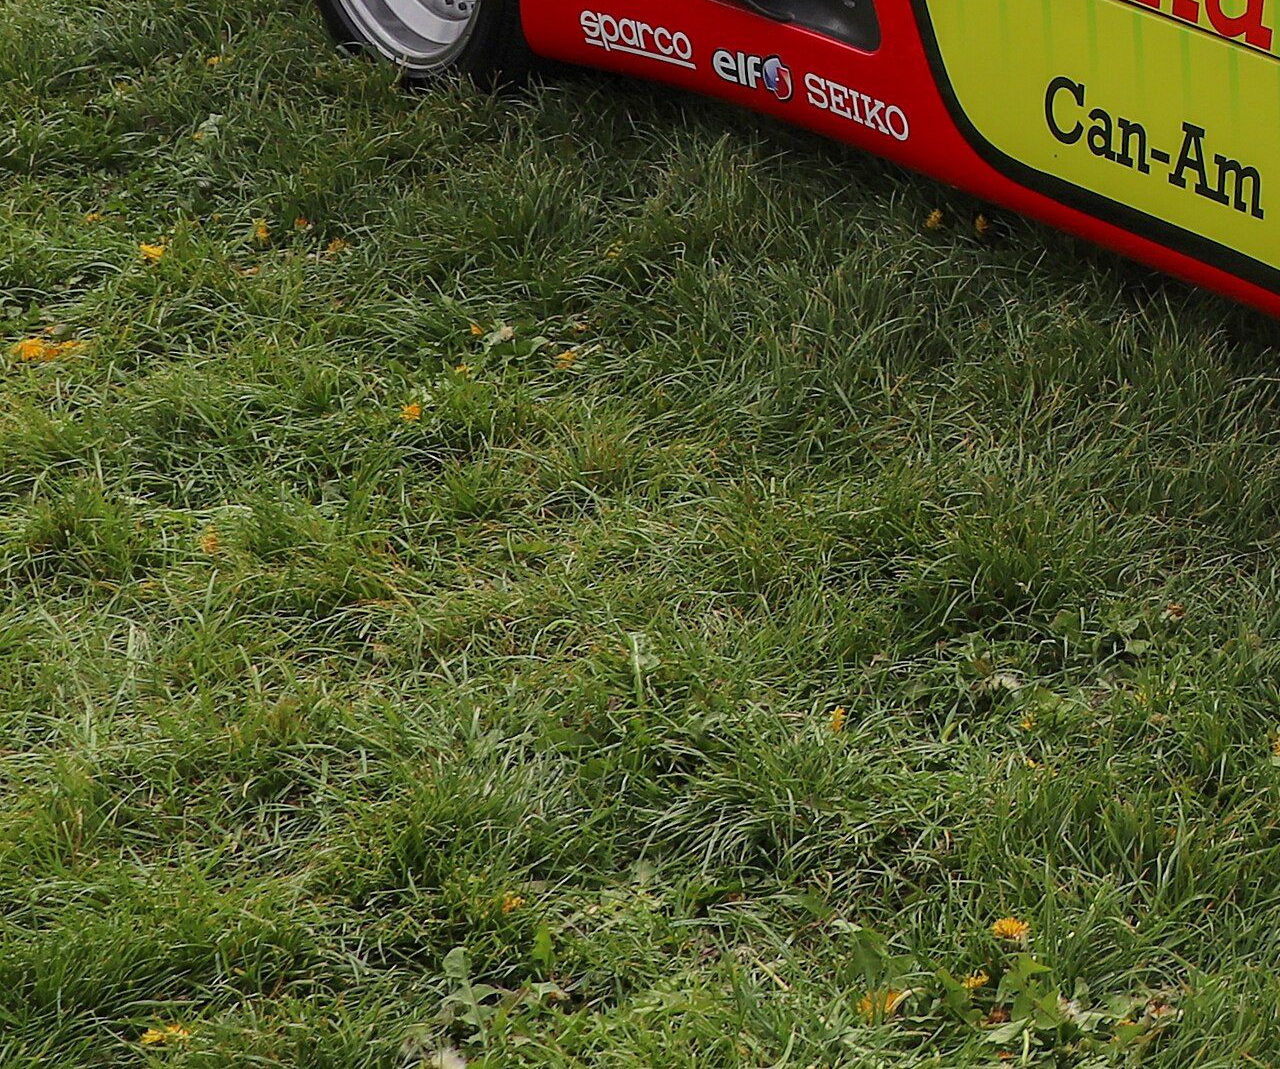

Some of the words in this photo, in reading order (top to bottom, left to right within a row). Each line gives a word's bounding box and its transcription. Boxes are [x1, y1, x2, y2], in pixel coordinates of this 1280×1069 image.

[579, 9, 694, 62] sparco
[712, 46, 765, 91] elf
[803, 72, 910, 142] SEIKO
[1043, 75, 1266, 220] Can-Am
